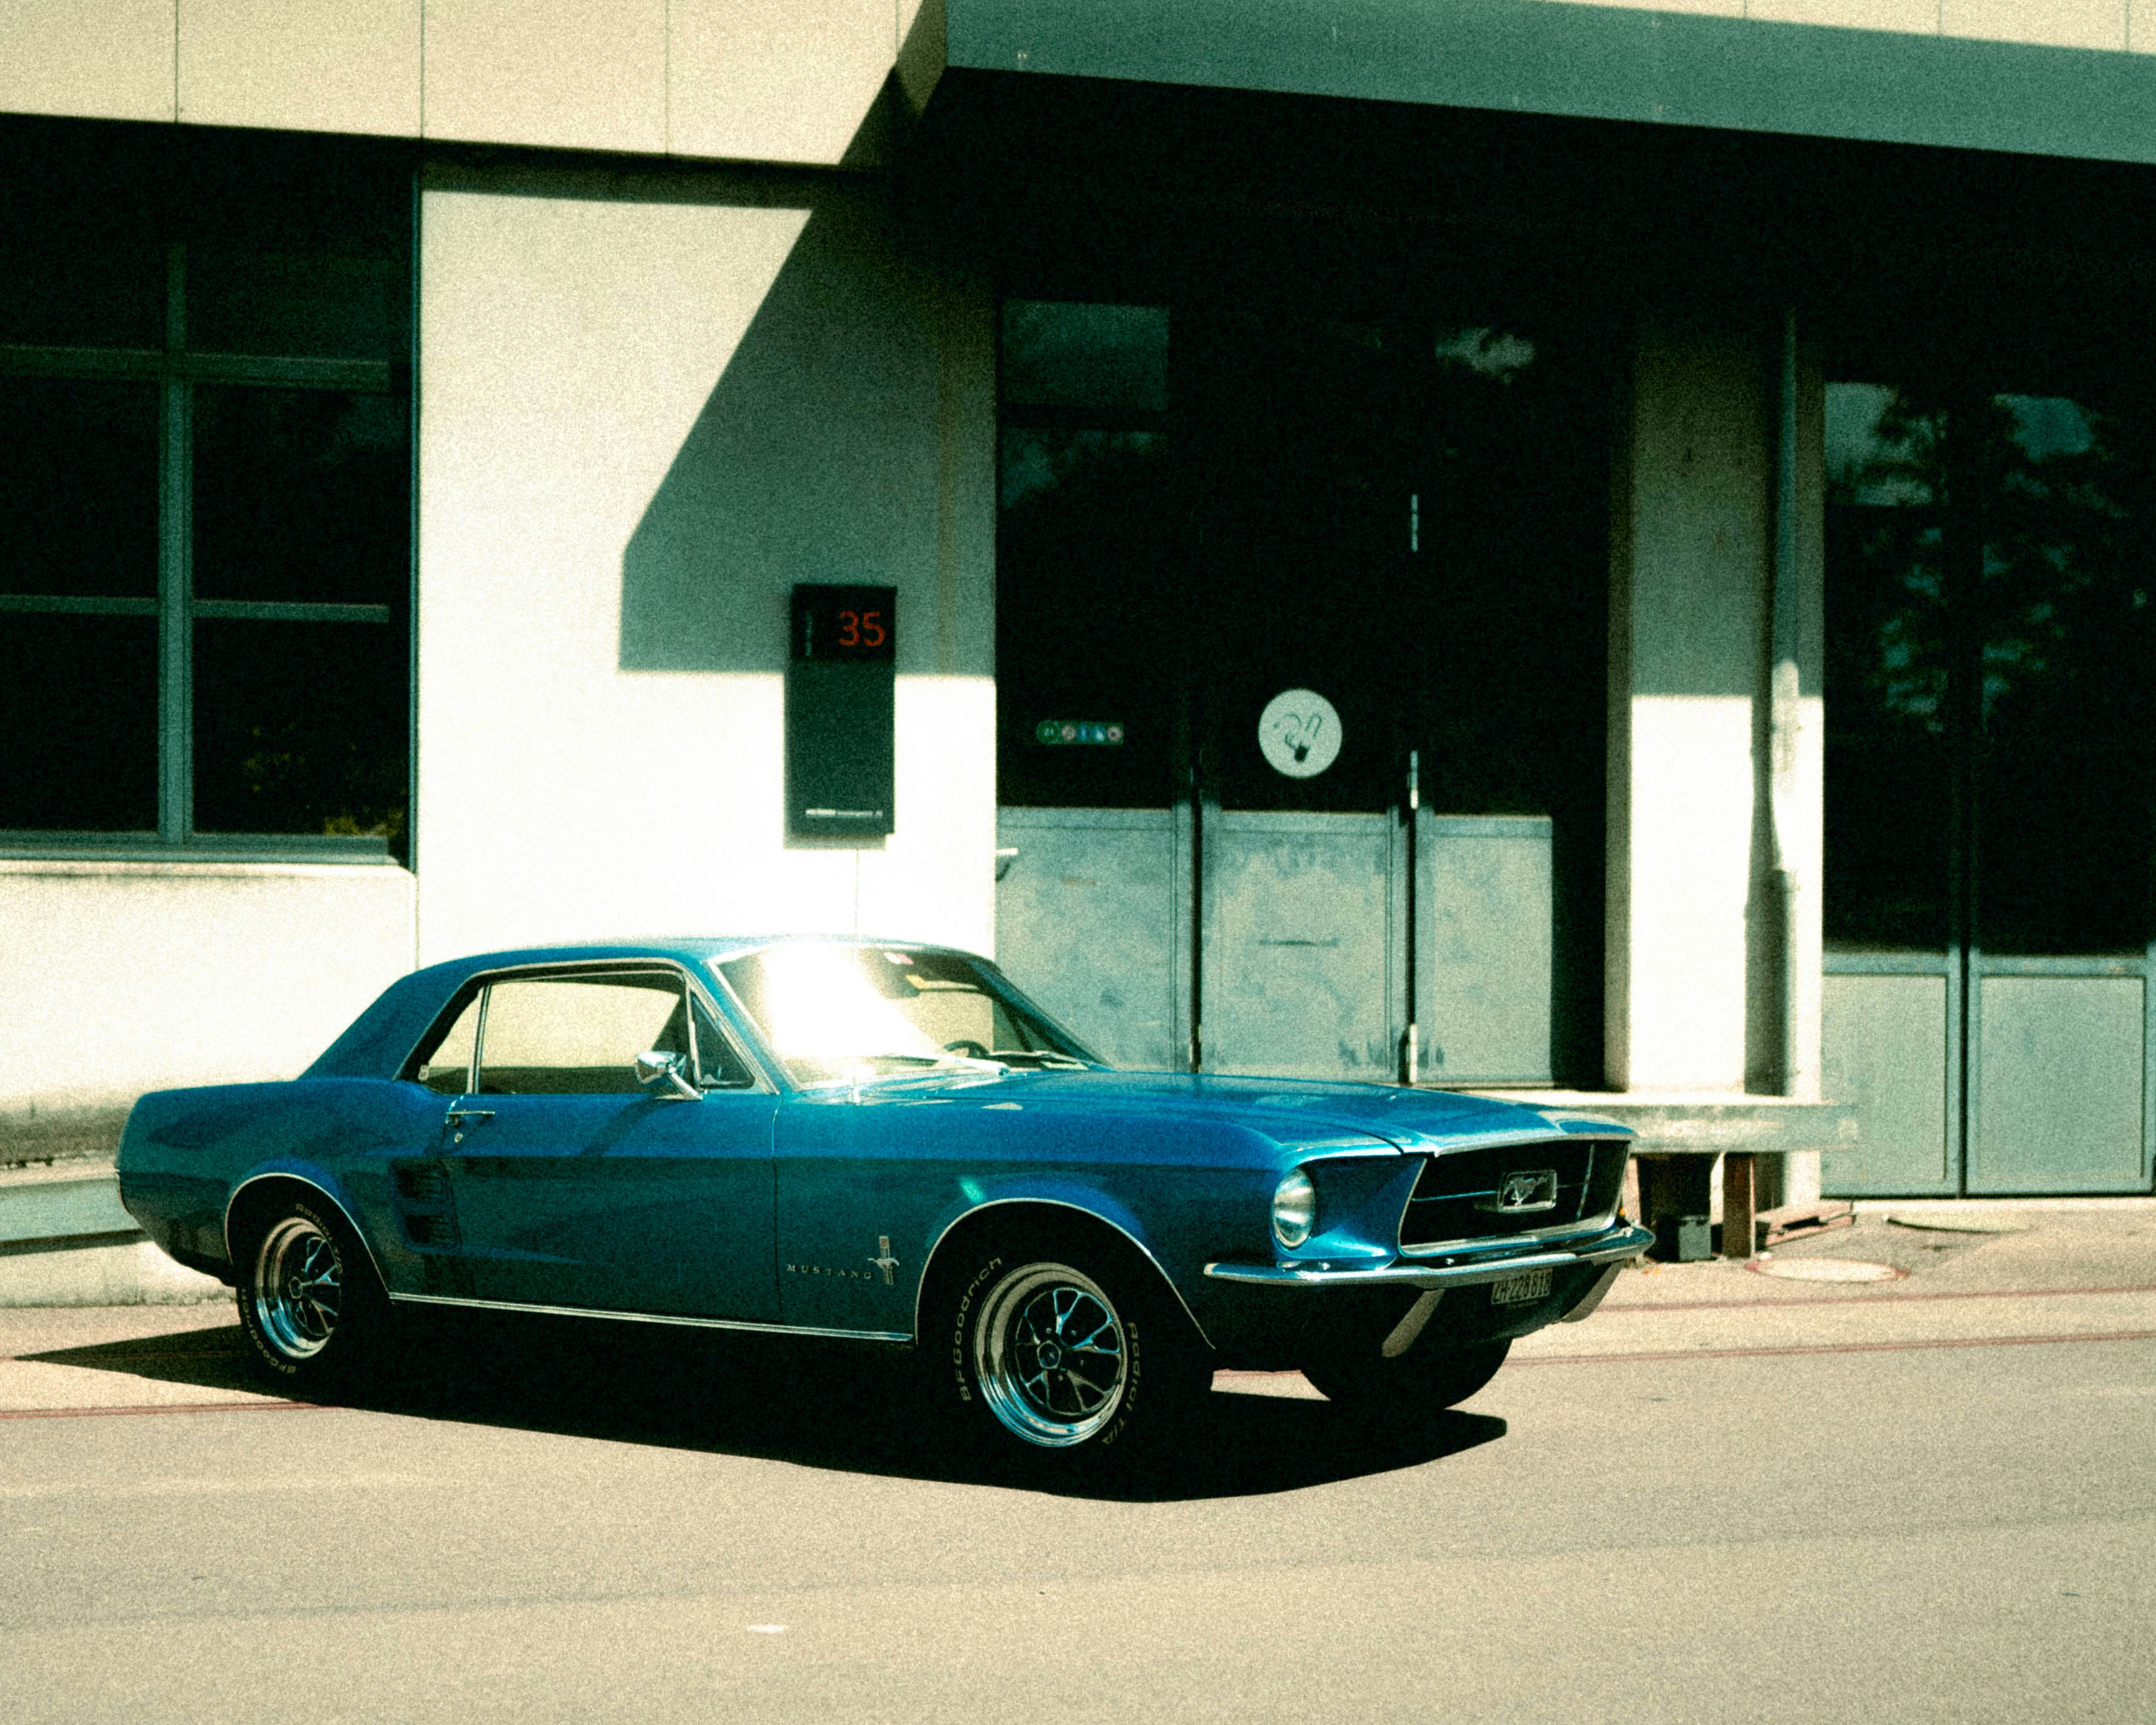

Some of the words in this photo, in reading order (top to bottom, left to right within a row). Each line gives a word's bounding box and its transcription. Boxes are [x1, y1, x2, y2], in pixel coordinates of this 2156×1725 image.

[838, 610, 886, 646] 35
[787, 1263, 873, 1280] MUSTANG
[952, 1256, 1003, 1402] BFGoodrich
